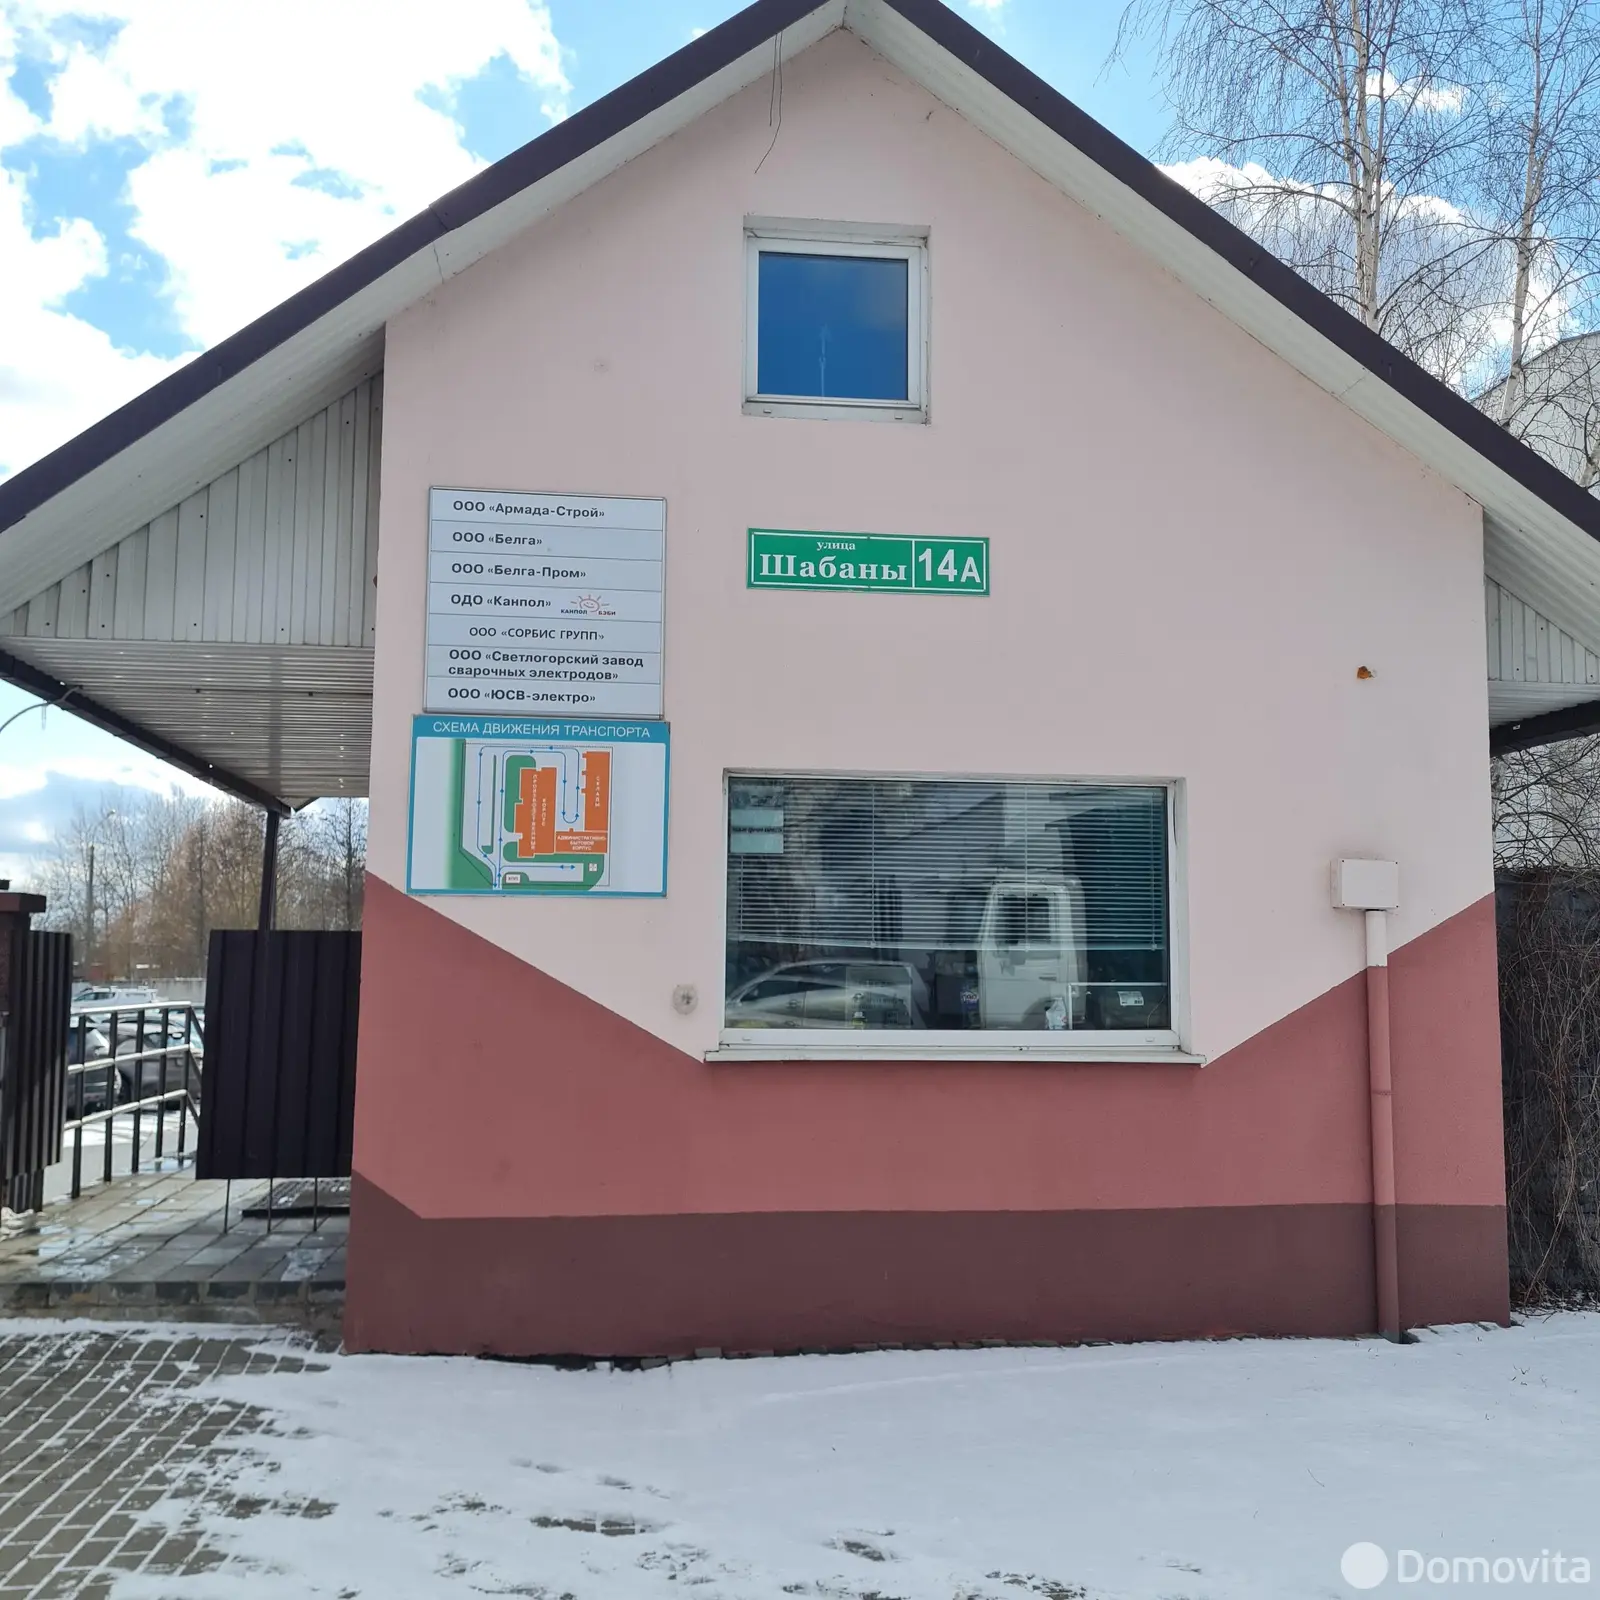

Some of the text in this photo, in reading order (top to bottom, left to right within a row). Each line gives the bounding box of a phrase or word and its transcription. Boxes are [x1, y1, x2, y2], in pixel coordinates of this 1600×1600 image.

[453, 500, 605, 519] ООО «Армада-Строй»
[452, 531, 543, 546] ООО «Белга»
[816, 541, 856, 551] улица
[451, 562, 586, 580] ООО «Белга-Пром»
[759, 553, 907, 581] Шабаны
[918, 547, 981, 583] 14А
[450, 594, 551, 608] ОДО «Канпол»
[469, 627, 605, 641] ООО «СОРБИС ГРУПП»
[449, 649, 644, 667] ООО «Светлогорский завод
[448, 665, 619, 681] сварочных электродов»
[448, 688, 596, 704] ООО «ЮСВ-электро»
[433, 721, 650, 738] СХЕМА ДВИЖЕНИЯ ТРАНСПОРТА
